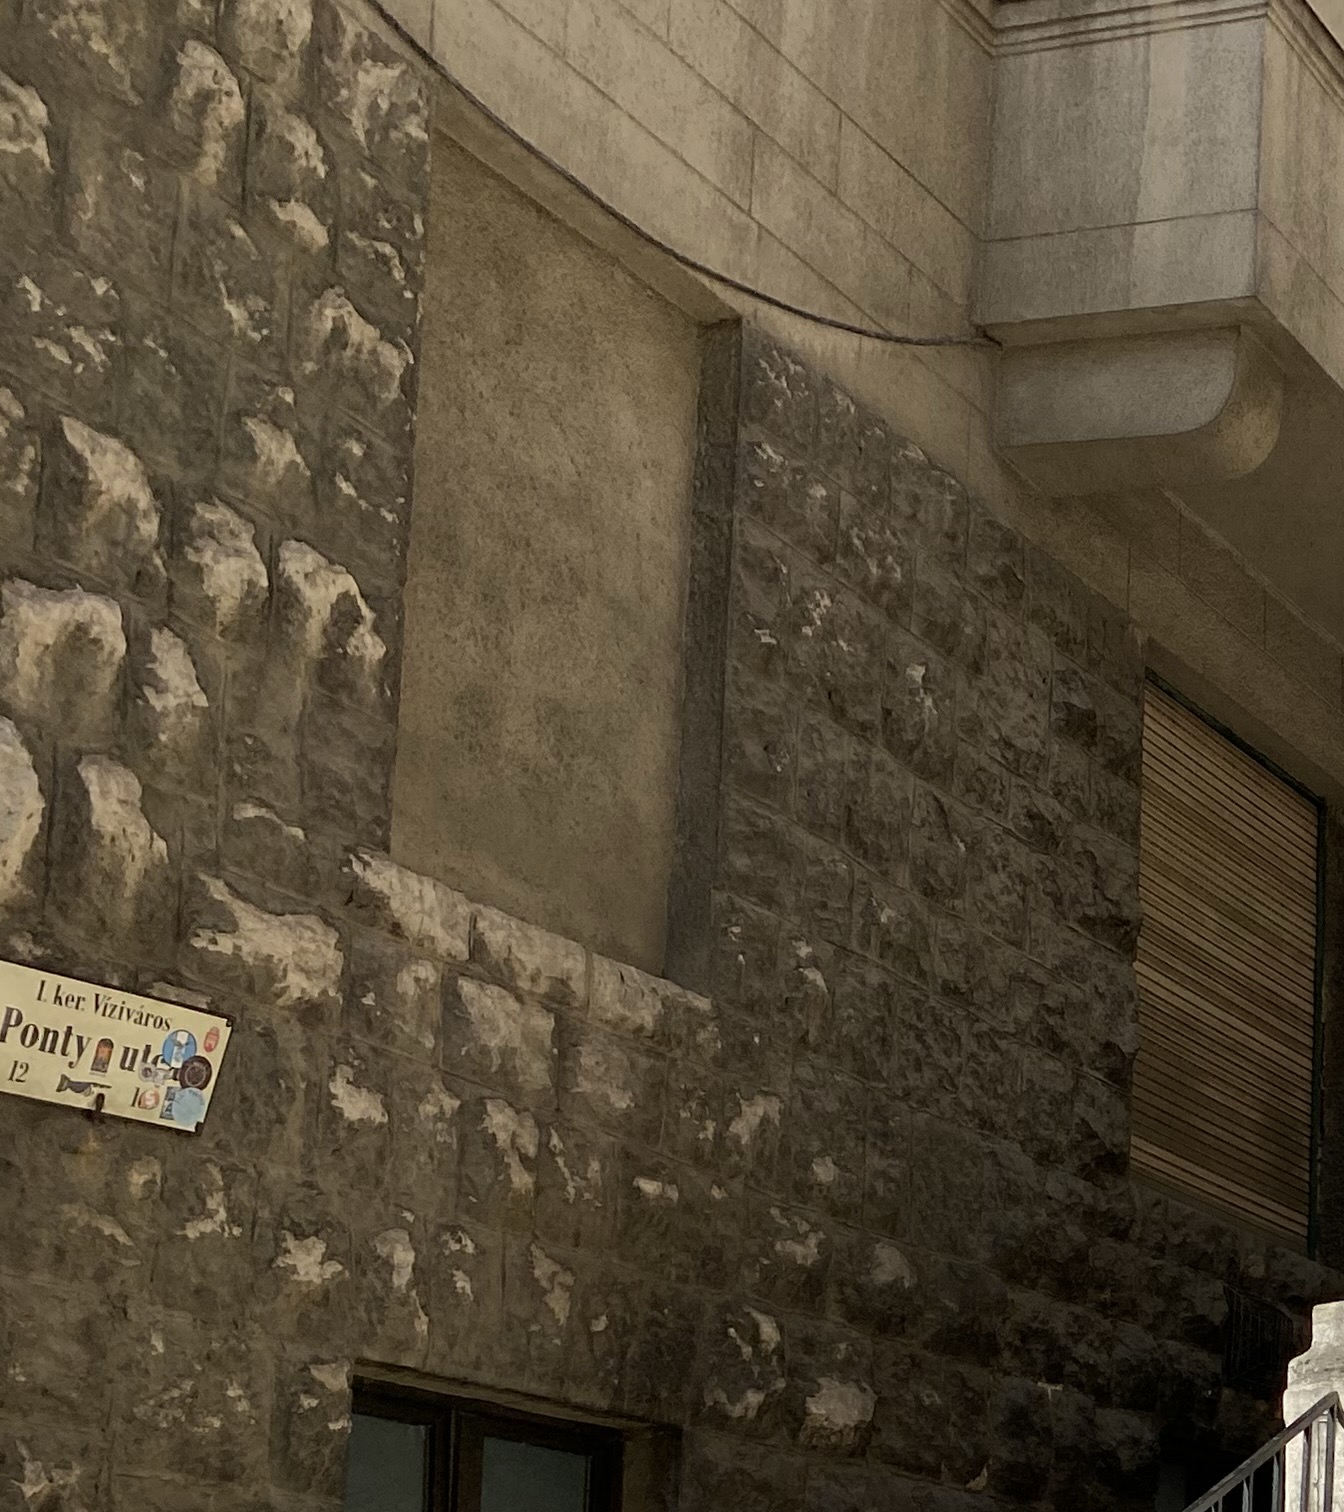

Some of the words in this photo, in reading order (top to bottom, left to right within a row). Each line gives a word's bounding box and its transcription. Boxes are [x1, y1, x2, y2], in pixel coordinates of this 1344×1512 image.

[53, 984, 86, 1012] ker.
[93, 992, 172, 1032] Víziváros
[0, 1006, 92, 1069] Ponty
[7, 1060, 30, 1084] 12
